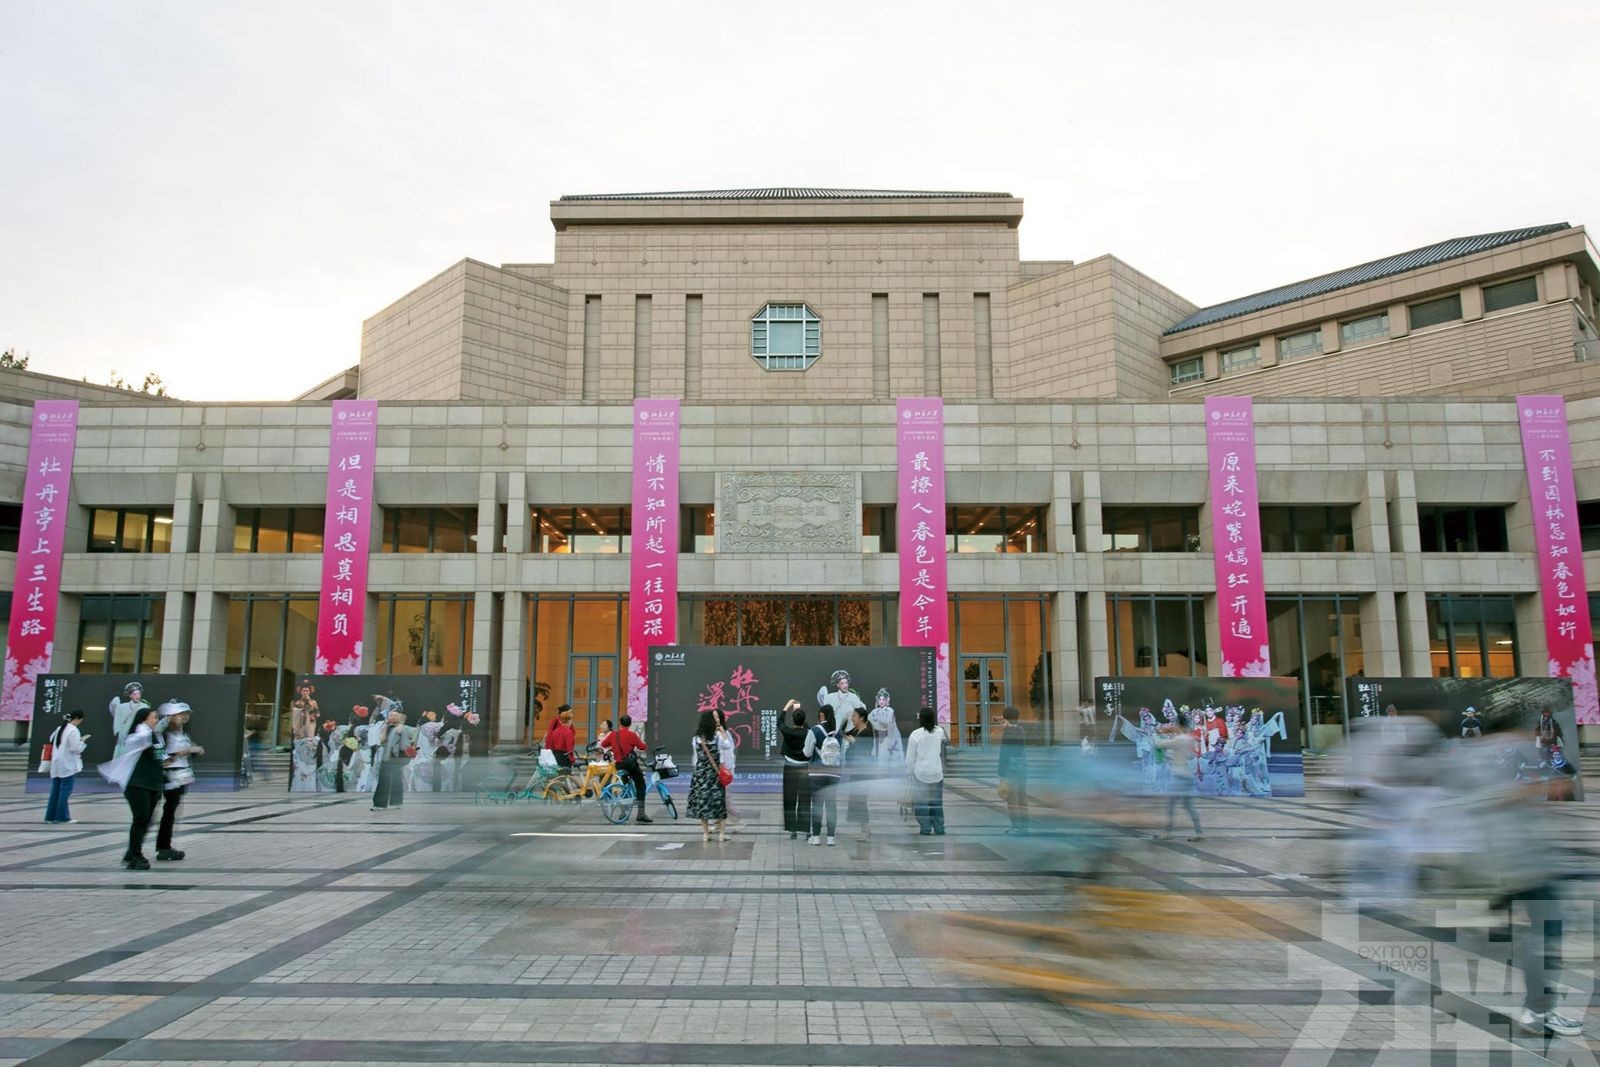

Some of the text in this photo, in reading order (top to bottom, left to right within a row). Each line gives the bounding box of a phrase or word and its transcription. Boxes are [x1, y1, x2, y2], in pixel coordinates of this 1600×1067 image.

[20, 456, 62, 637] 牡丹亭上三生路
[329, 453, 363, 636] 但是相思莫相负
[642, 454, 667, 637] 情不知所起一往而深
[910, 450, 936, 639] 最撩人春色是今年
[1220, 451, 1252, 639] 原来姹紫嫣红开遍
[1538, 448, 1577, 640] 不到园林怎知春色如许
